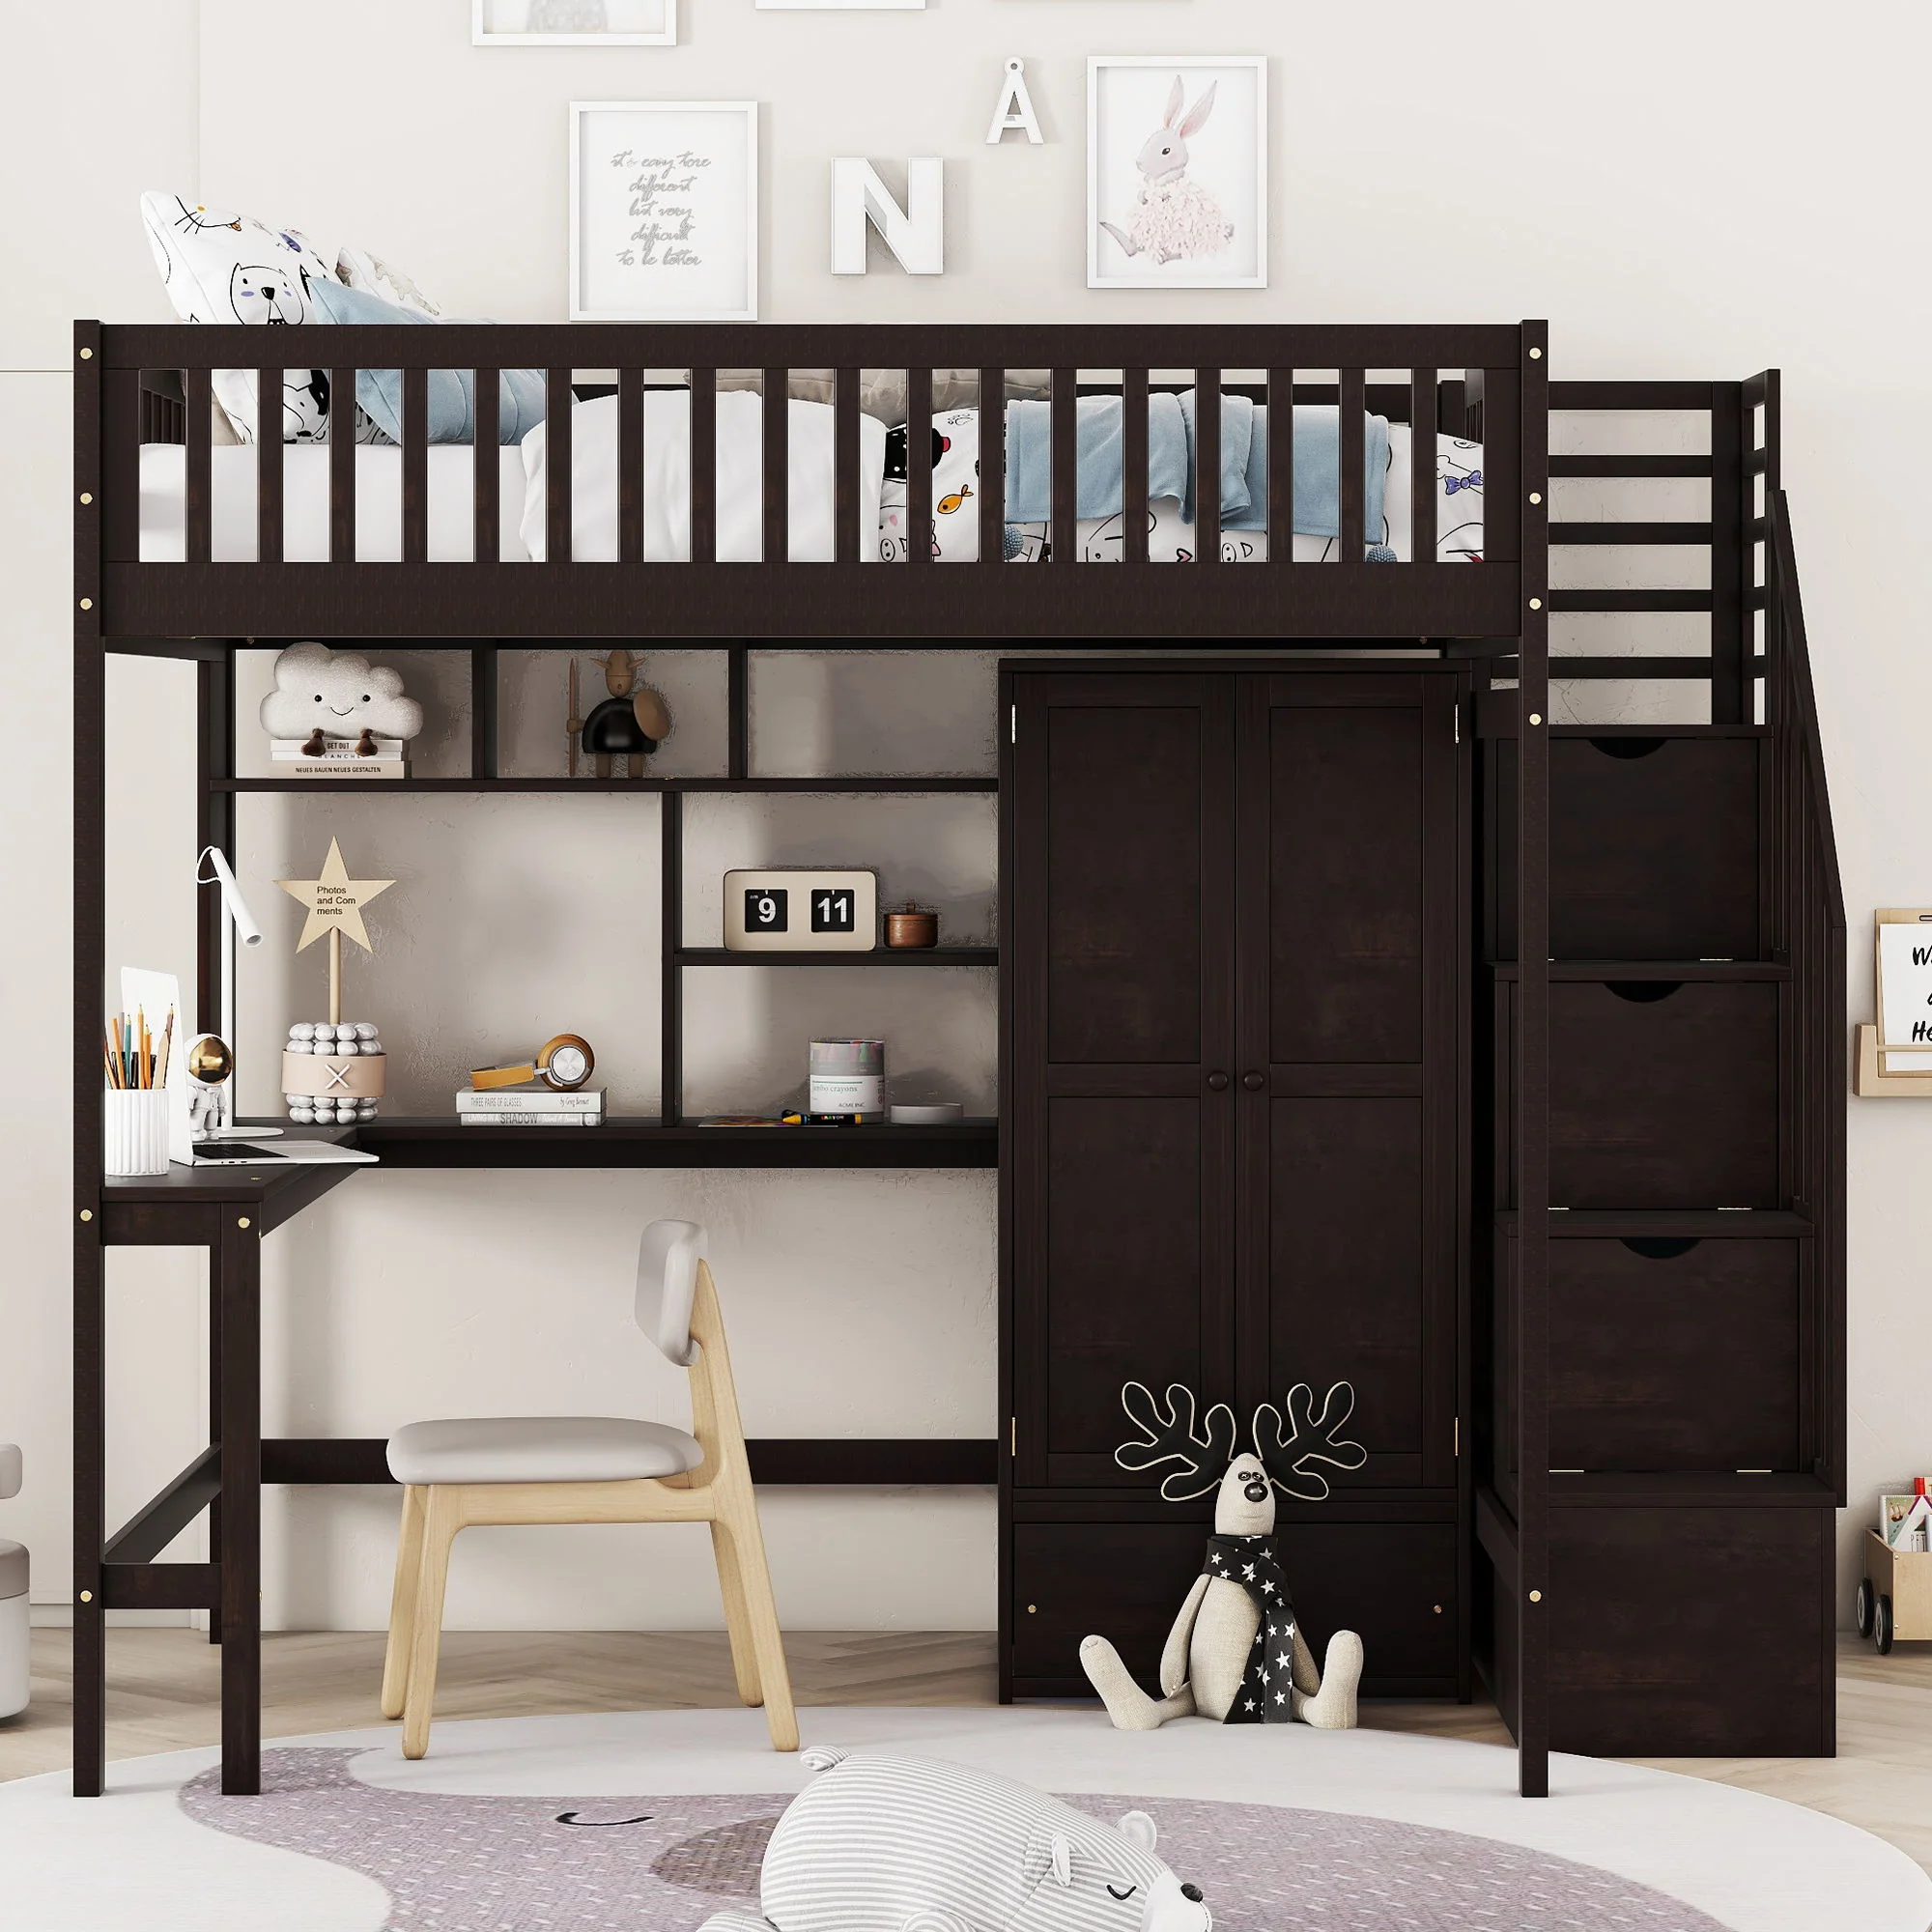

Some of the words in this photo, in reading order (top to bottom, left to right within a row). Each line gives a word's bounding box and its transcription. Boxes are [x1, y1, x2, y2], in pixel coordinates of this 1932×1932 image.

[629, 174, 697, 202] different
[831, 156, 944, 275] N
[615, 248, 635, 266] to
[317, 886, 347, 895] Photos
[335, 896, 356, 905] Com
[758, 897, 777, 923] 9
[817, 897, 847, 923] 11
[500, 1113, 538, 1124] SHADOW
